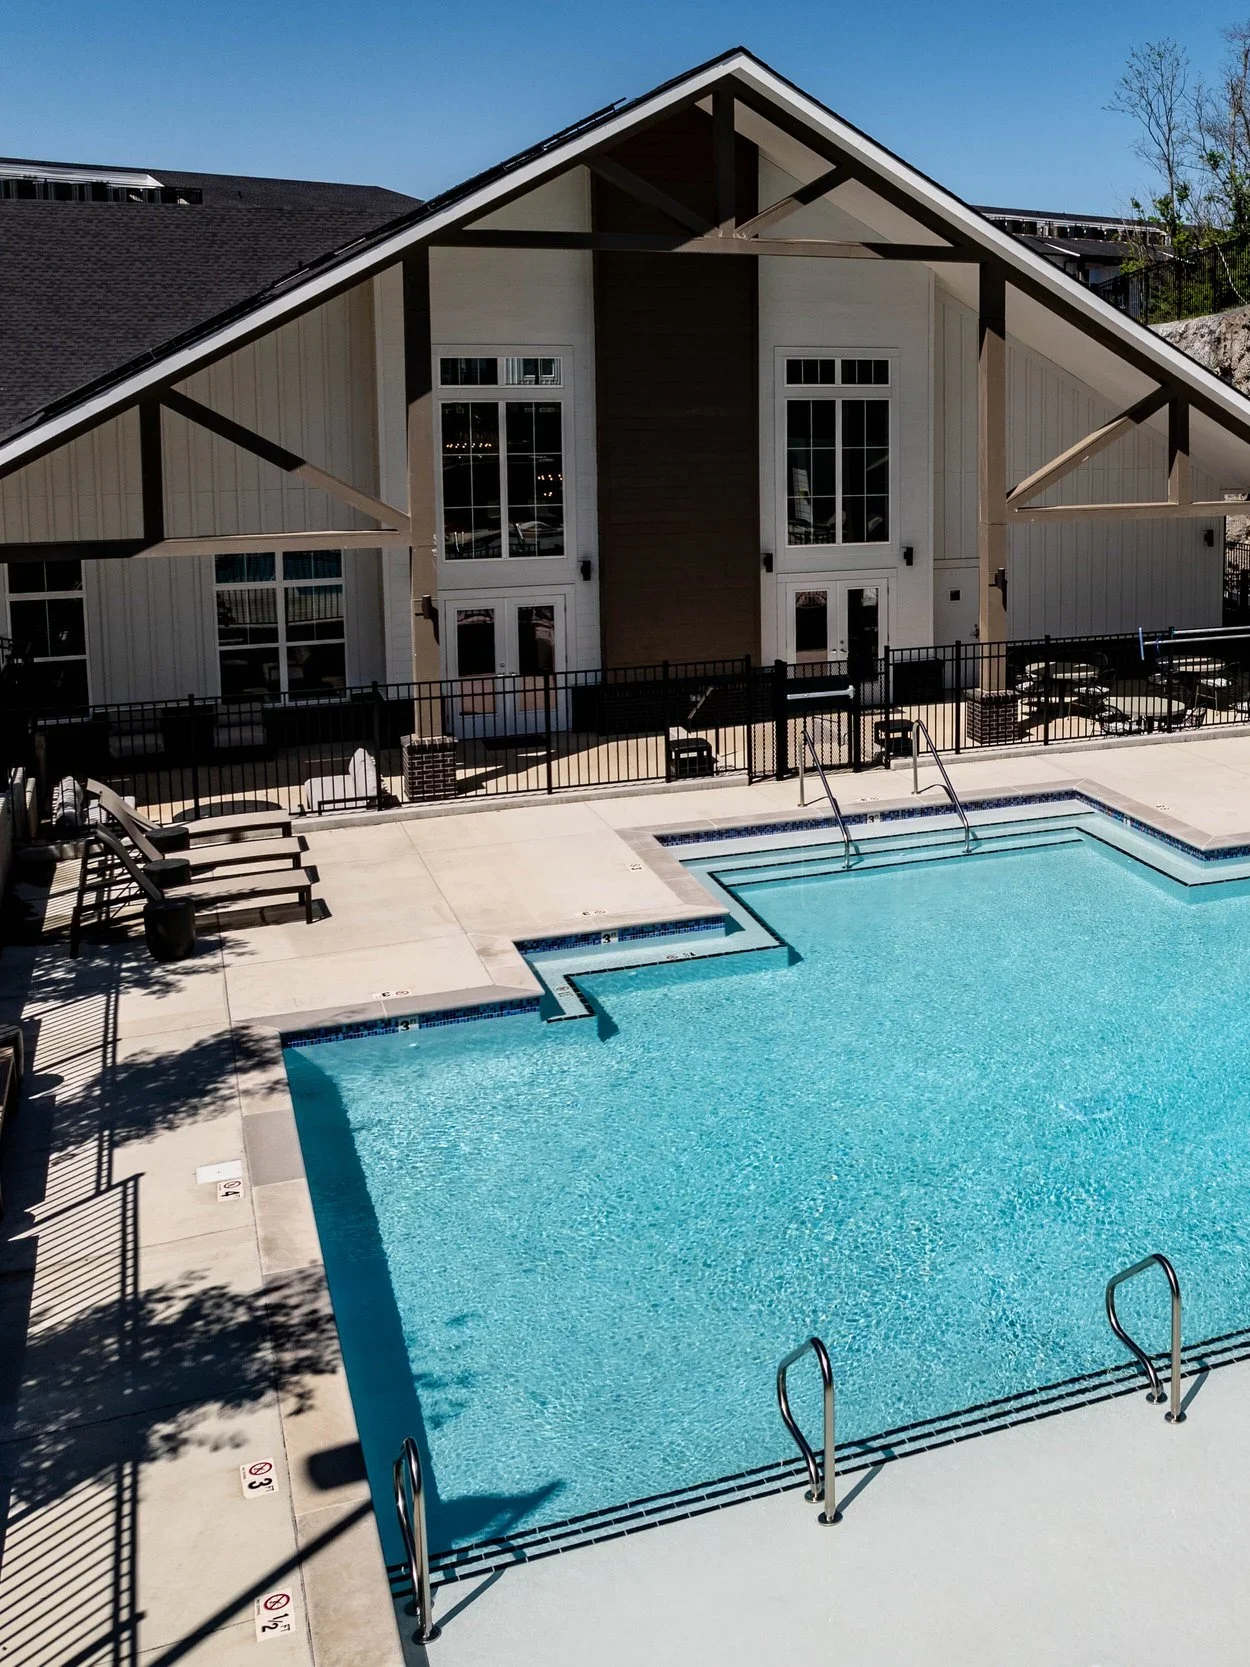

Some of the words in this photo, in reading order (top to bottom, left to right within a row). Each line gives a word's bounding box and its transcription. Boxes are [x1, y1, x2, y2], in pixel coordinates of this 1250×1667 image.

[602, 933, 611, 943] 3
[400, 1020, 410, 1030] 3
[248, 1477, 273, 1490] 3
[261, 1613, 289, 1633] 1/2
[280, 1623, 291, 1632] FT
